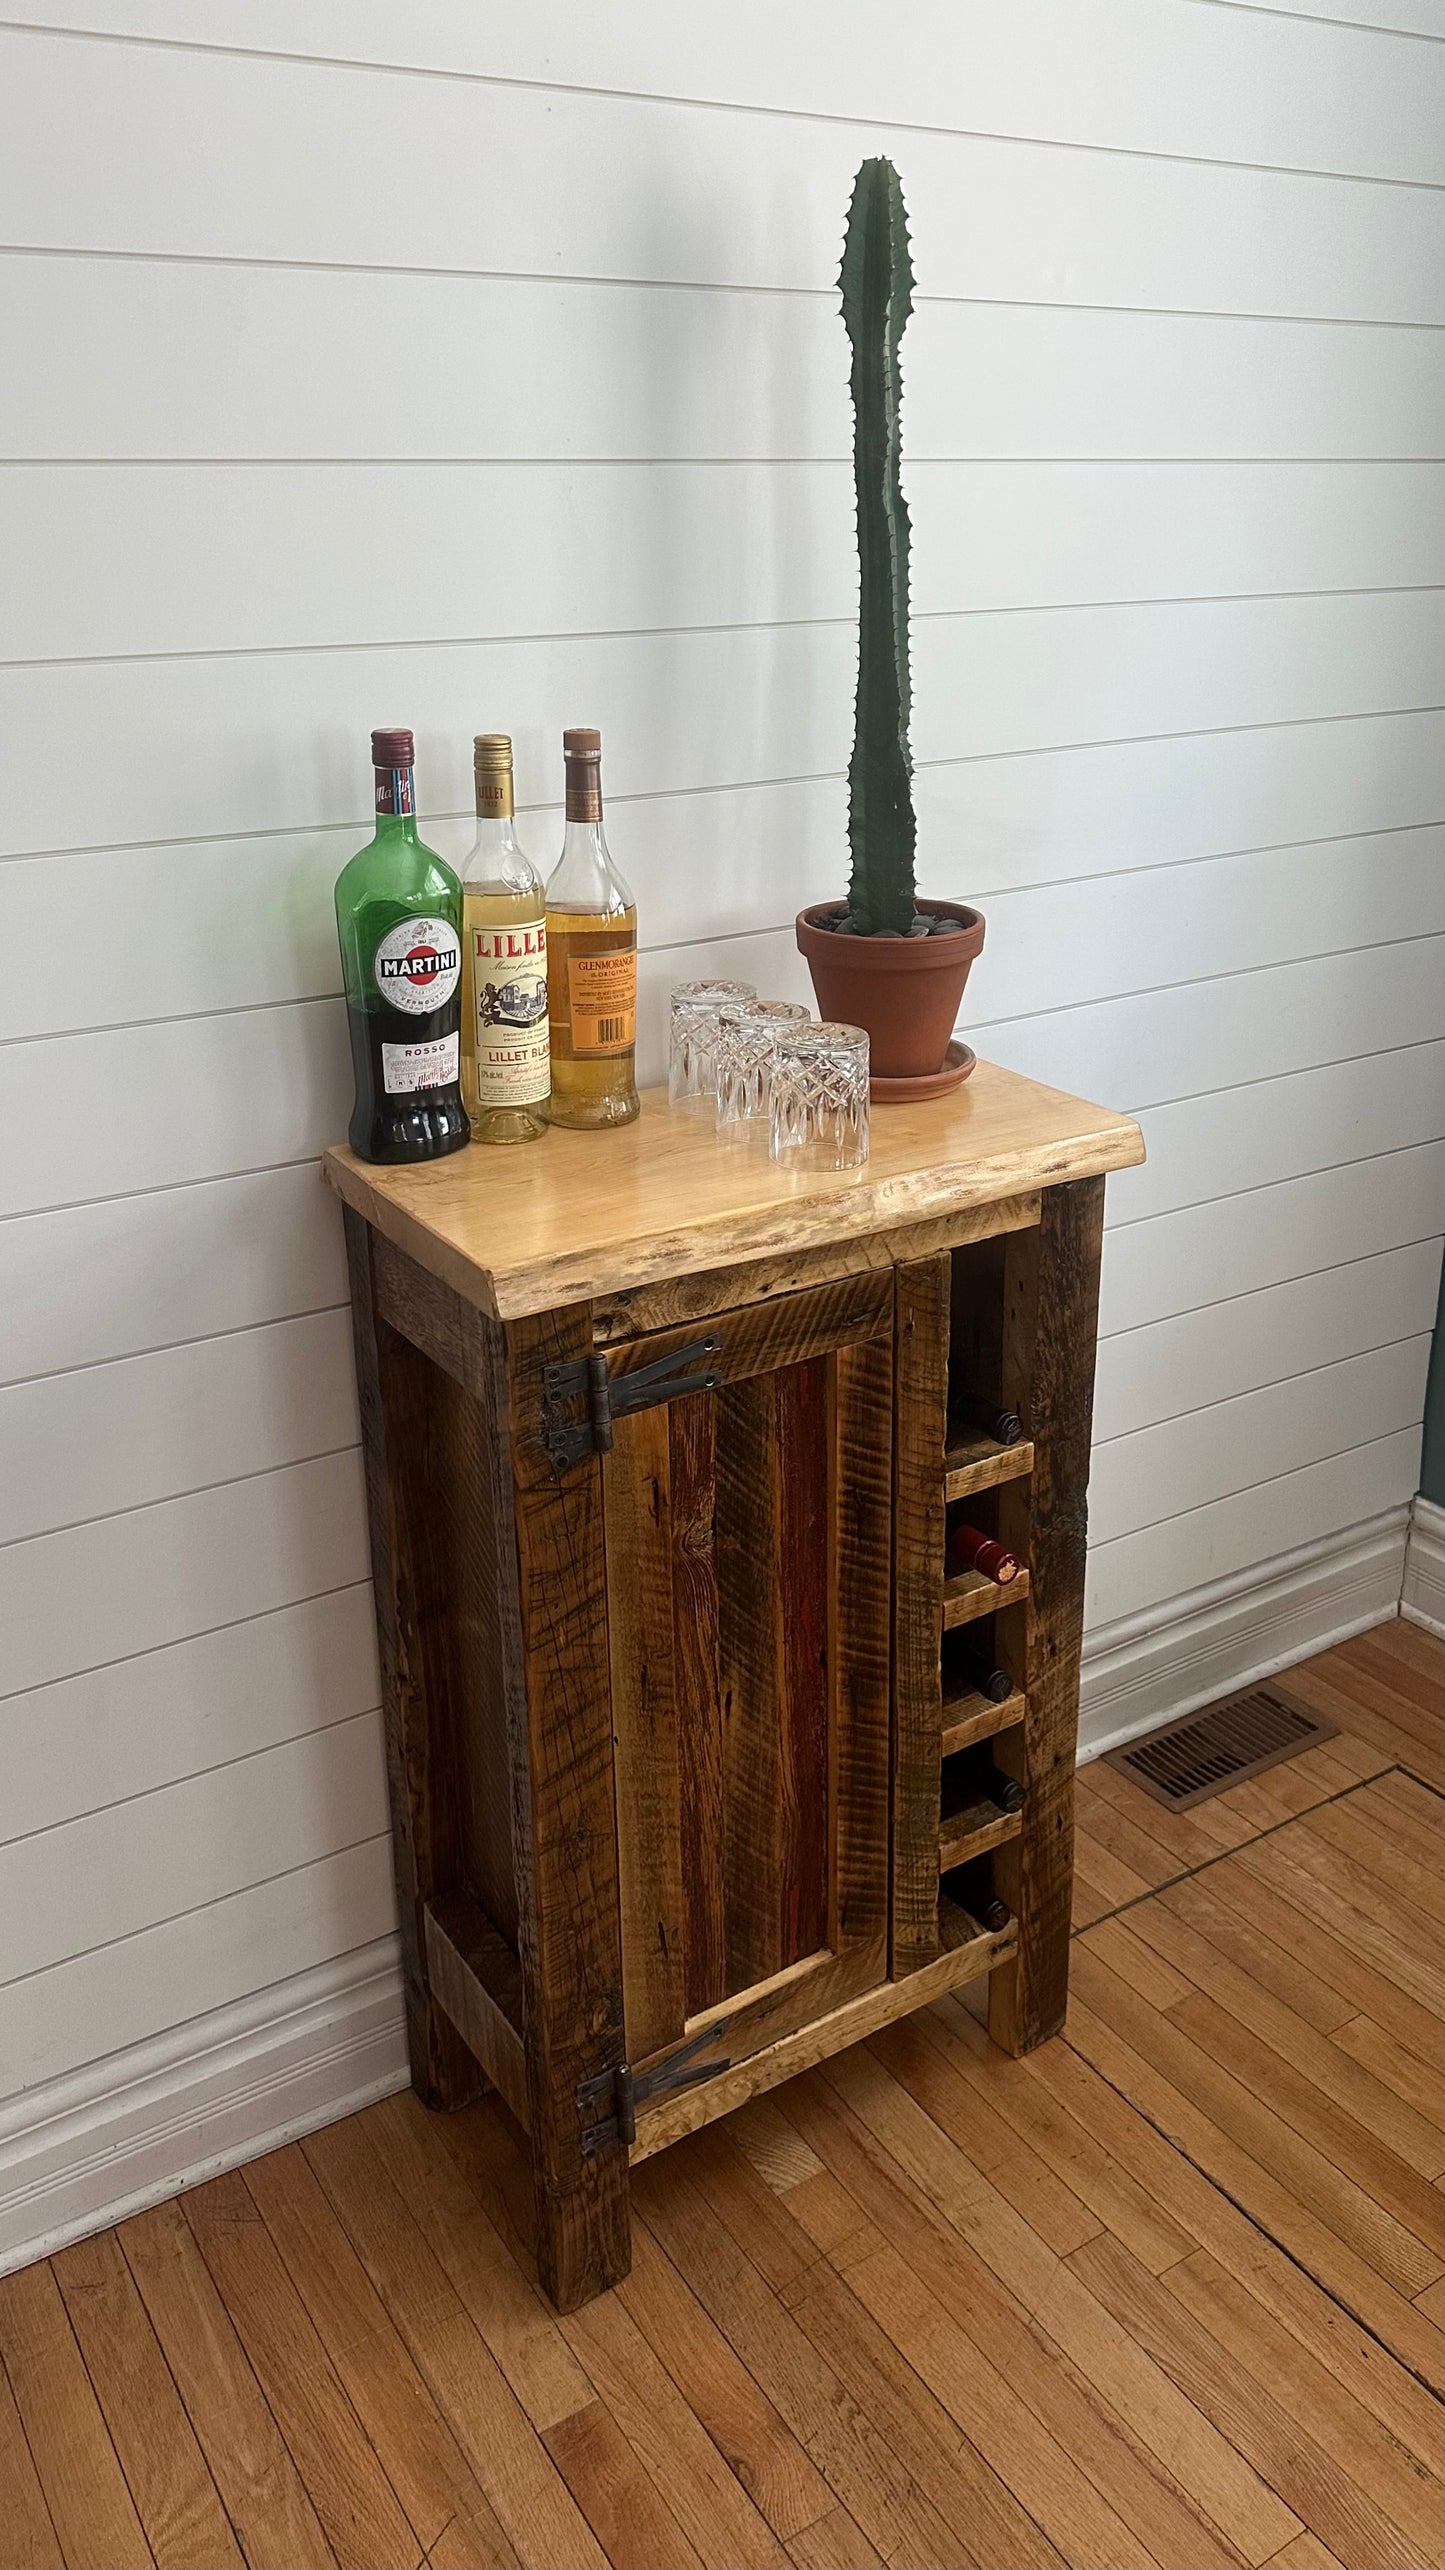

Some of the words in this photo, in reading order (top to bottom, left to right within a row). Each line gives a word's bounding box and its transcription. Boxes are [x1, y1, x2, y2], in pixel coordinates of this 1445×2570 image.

[476, 929, 546, 958] LILLE
[384, 951, 455, 976] MARTINI
[405, 1044, 446, 1057] ROSSO
[489, 1049, 528, 1062] LILLET
